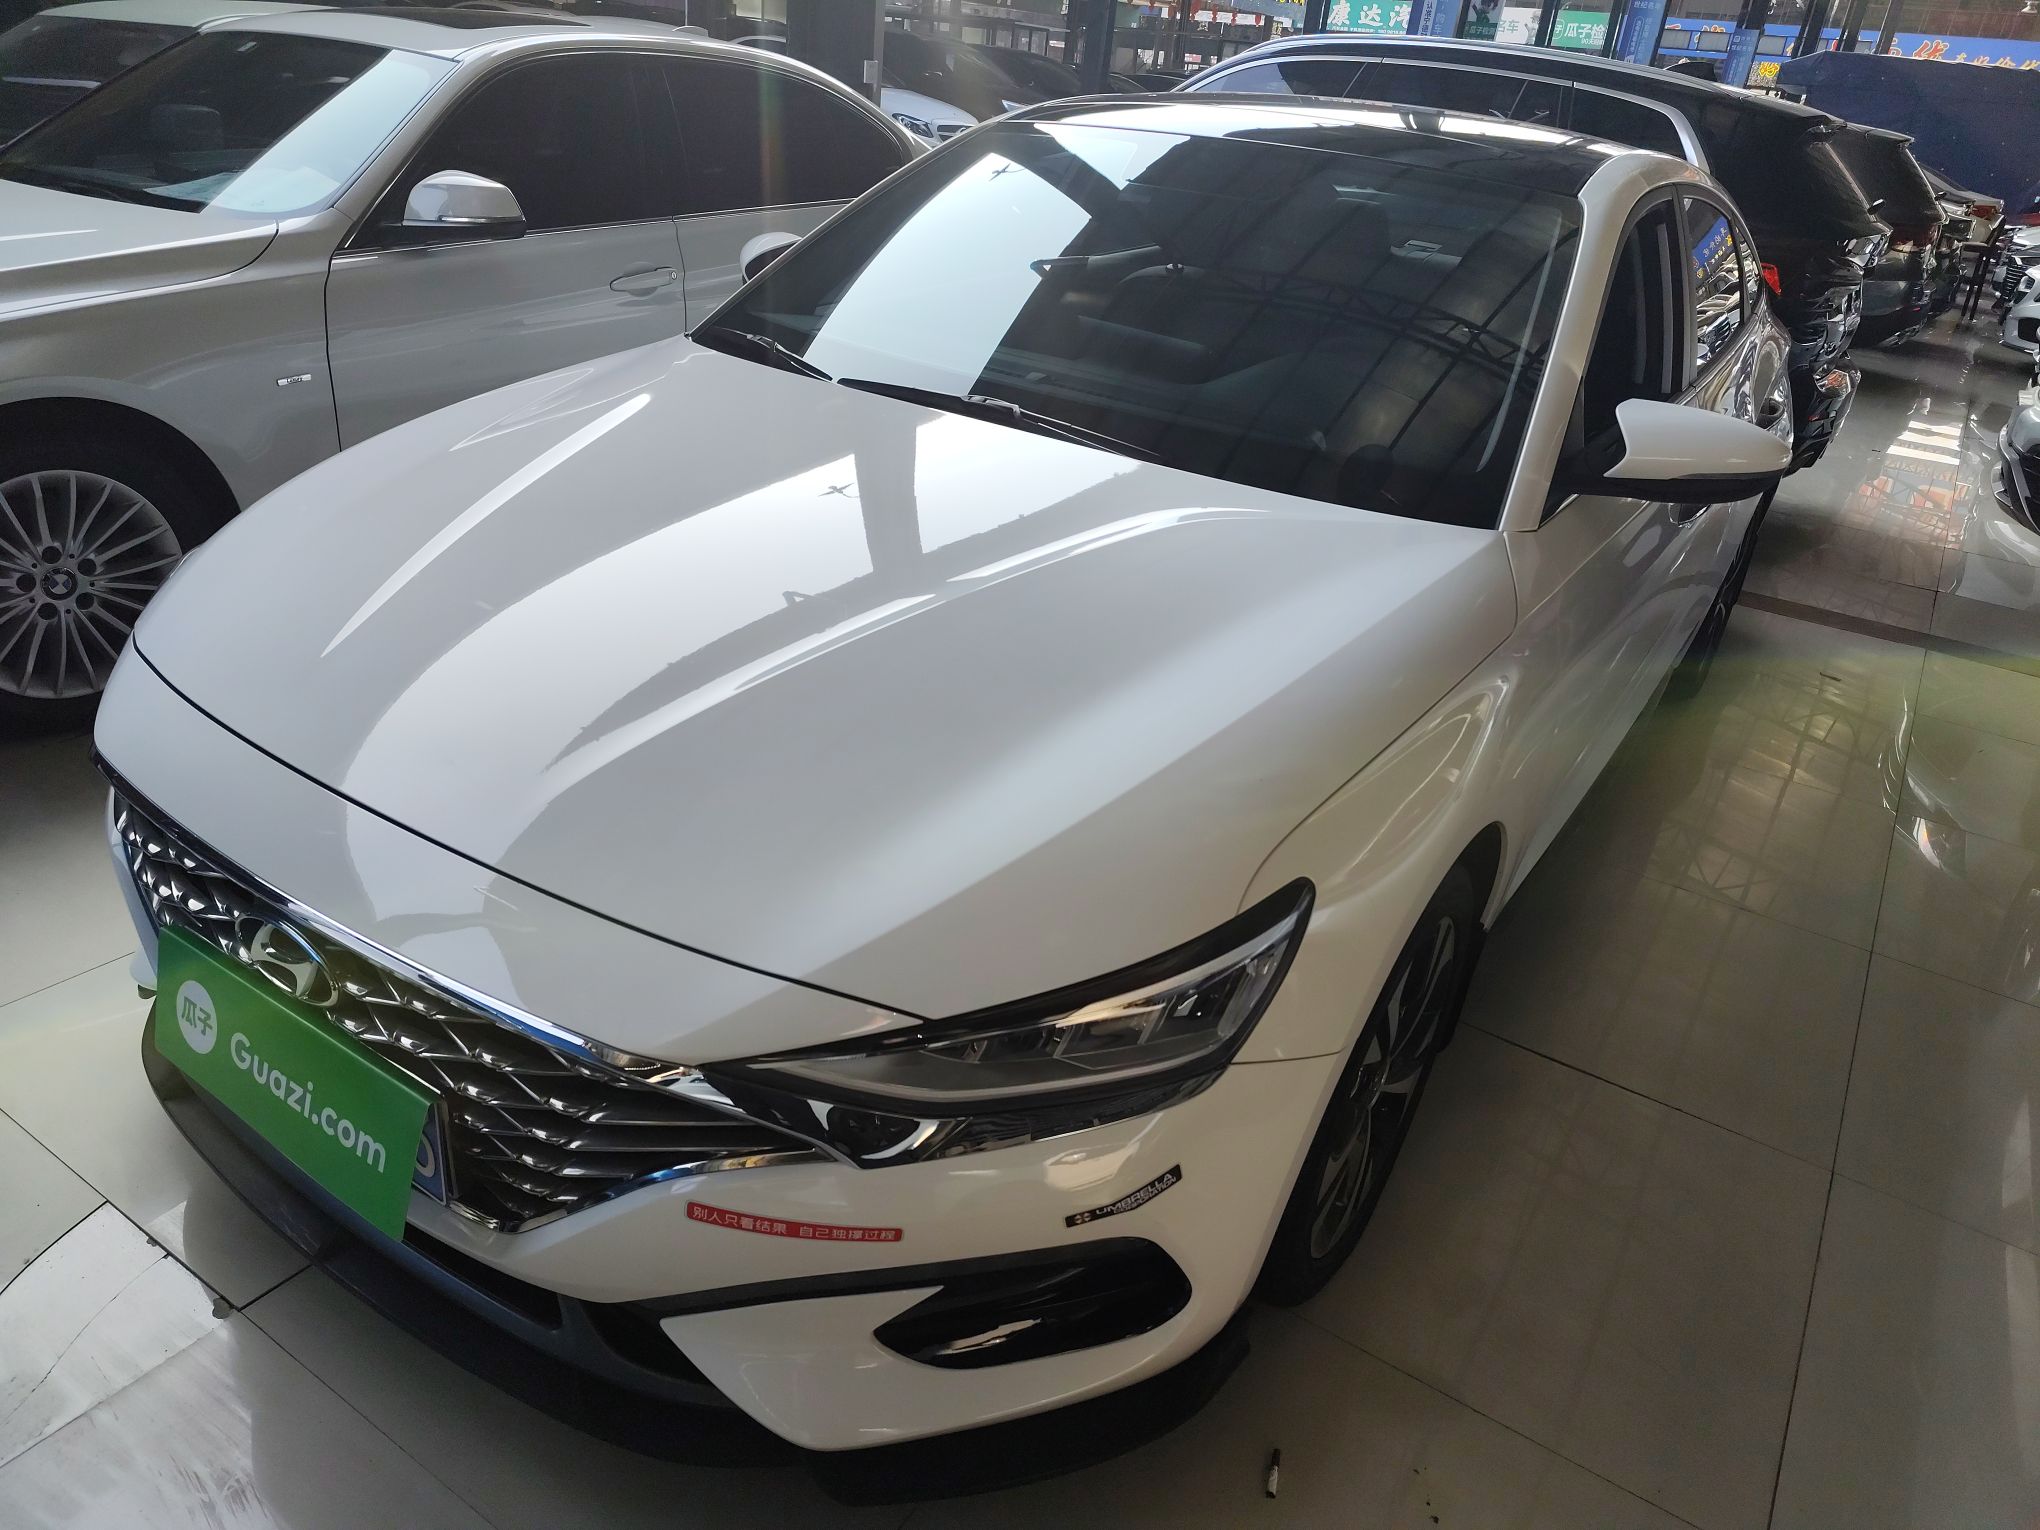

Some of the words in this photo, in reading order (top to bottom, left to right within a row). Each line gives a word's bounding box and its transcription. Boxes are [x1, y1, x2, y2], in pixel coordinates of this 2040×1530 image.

[181, 994, 214, 1037] 瓜子
[230, 1032, 387, 1174] Guazi.com
[1096, 1173, 1173, 1215] UMBRELLA
[692, 1206, 788, 1235] 别人只看结果
